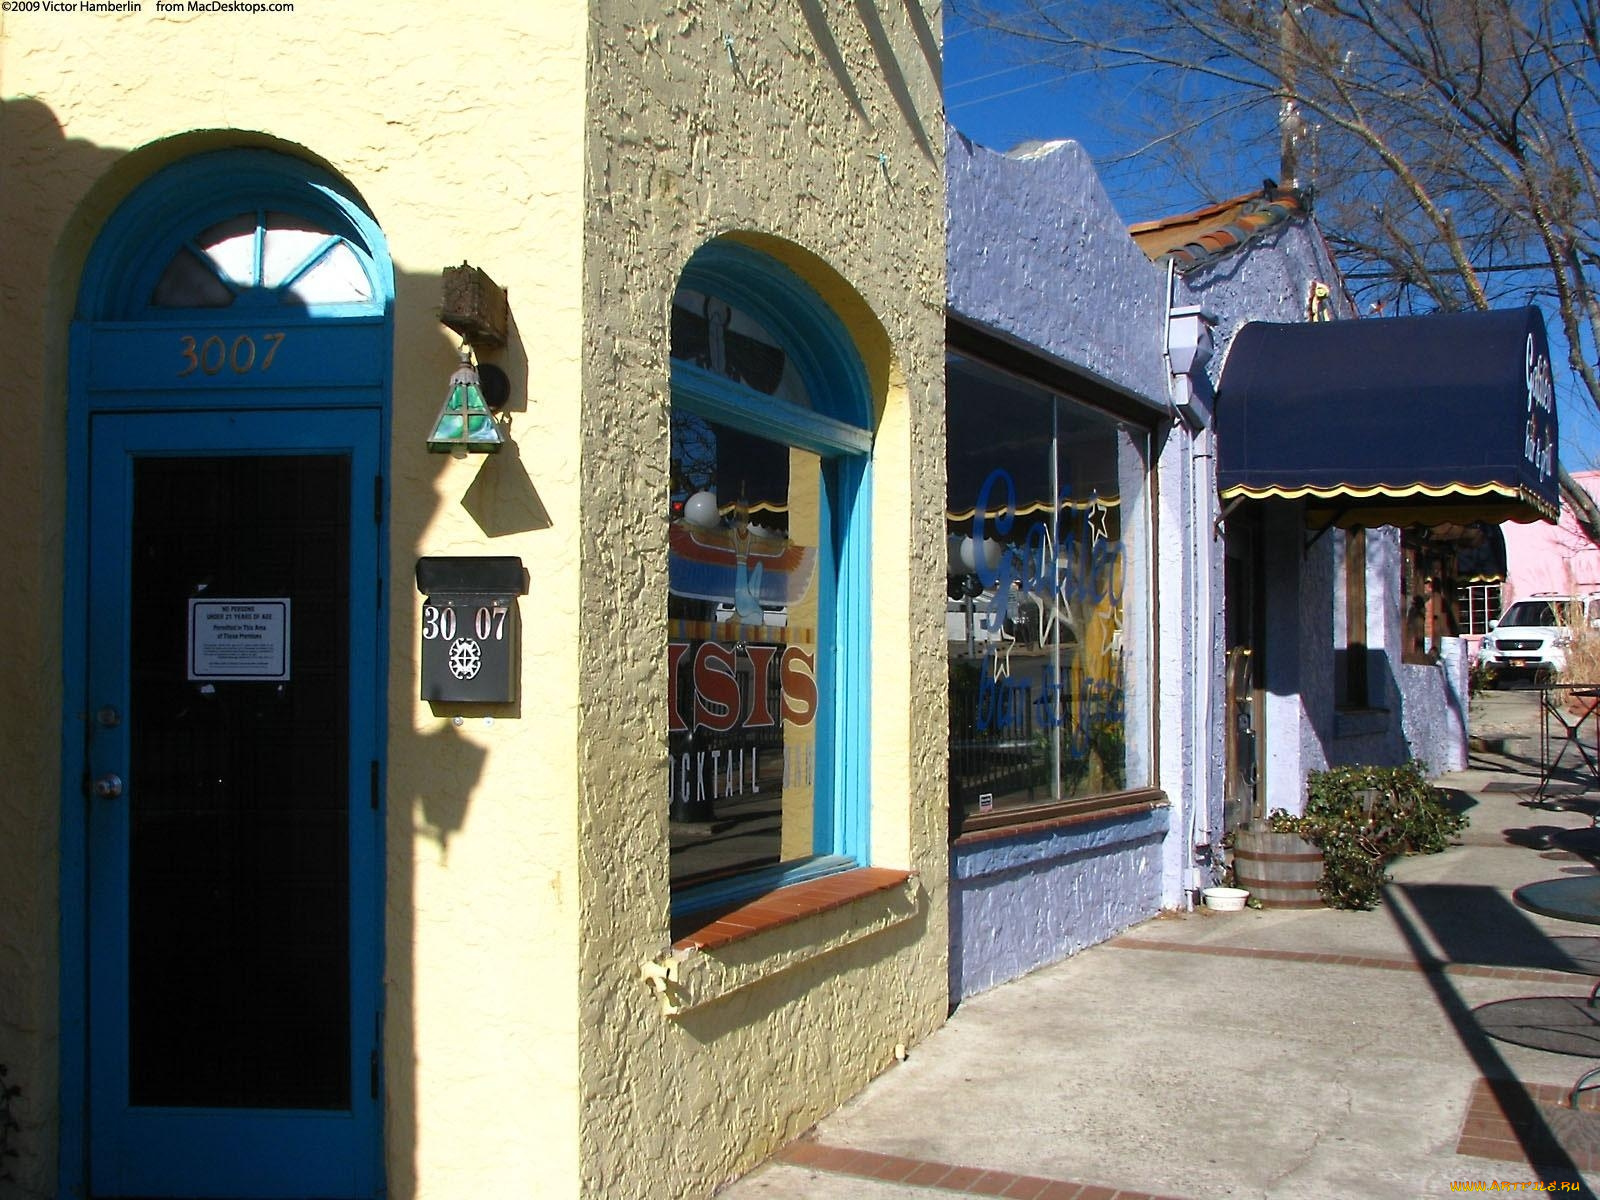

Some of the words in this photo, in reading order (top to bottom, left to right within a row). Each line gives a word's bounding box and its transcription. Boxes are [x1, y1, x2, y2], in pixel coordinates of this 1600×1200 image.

[177, 332, 286, 378] 3007
[423, 606, 457, 641] 30
[475, 606, 508, 641] 07
[668, 641, 819, 733] ISIS
[976, 644, 1032, 732] bar
[668, 746, 760, 804] OCKTAIL
